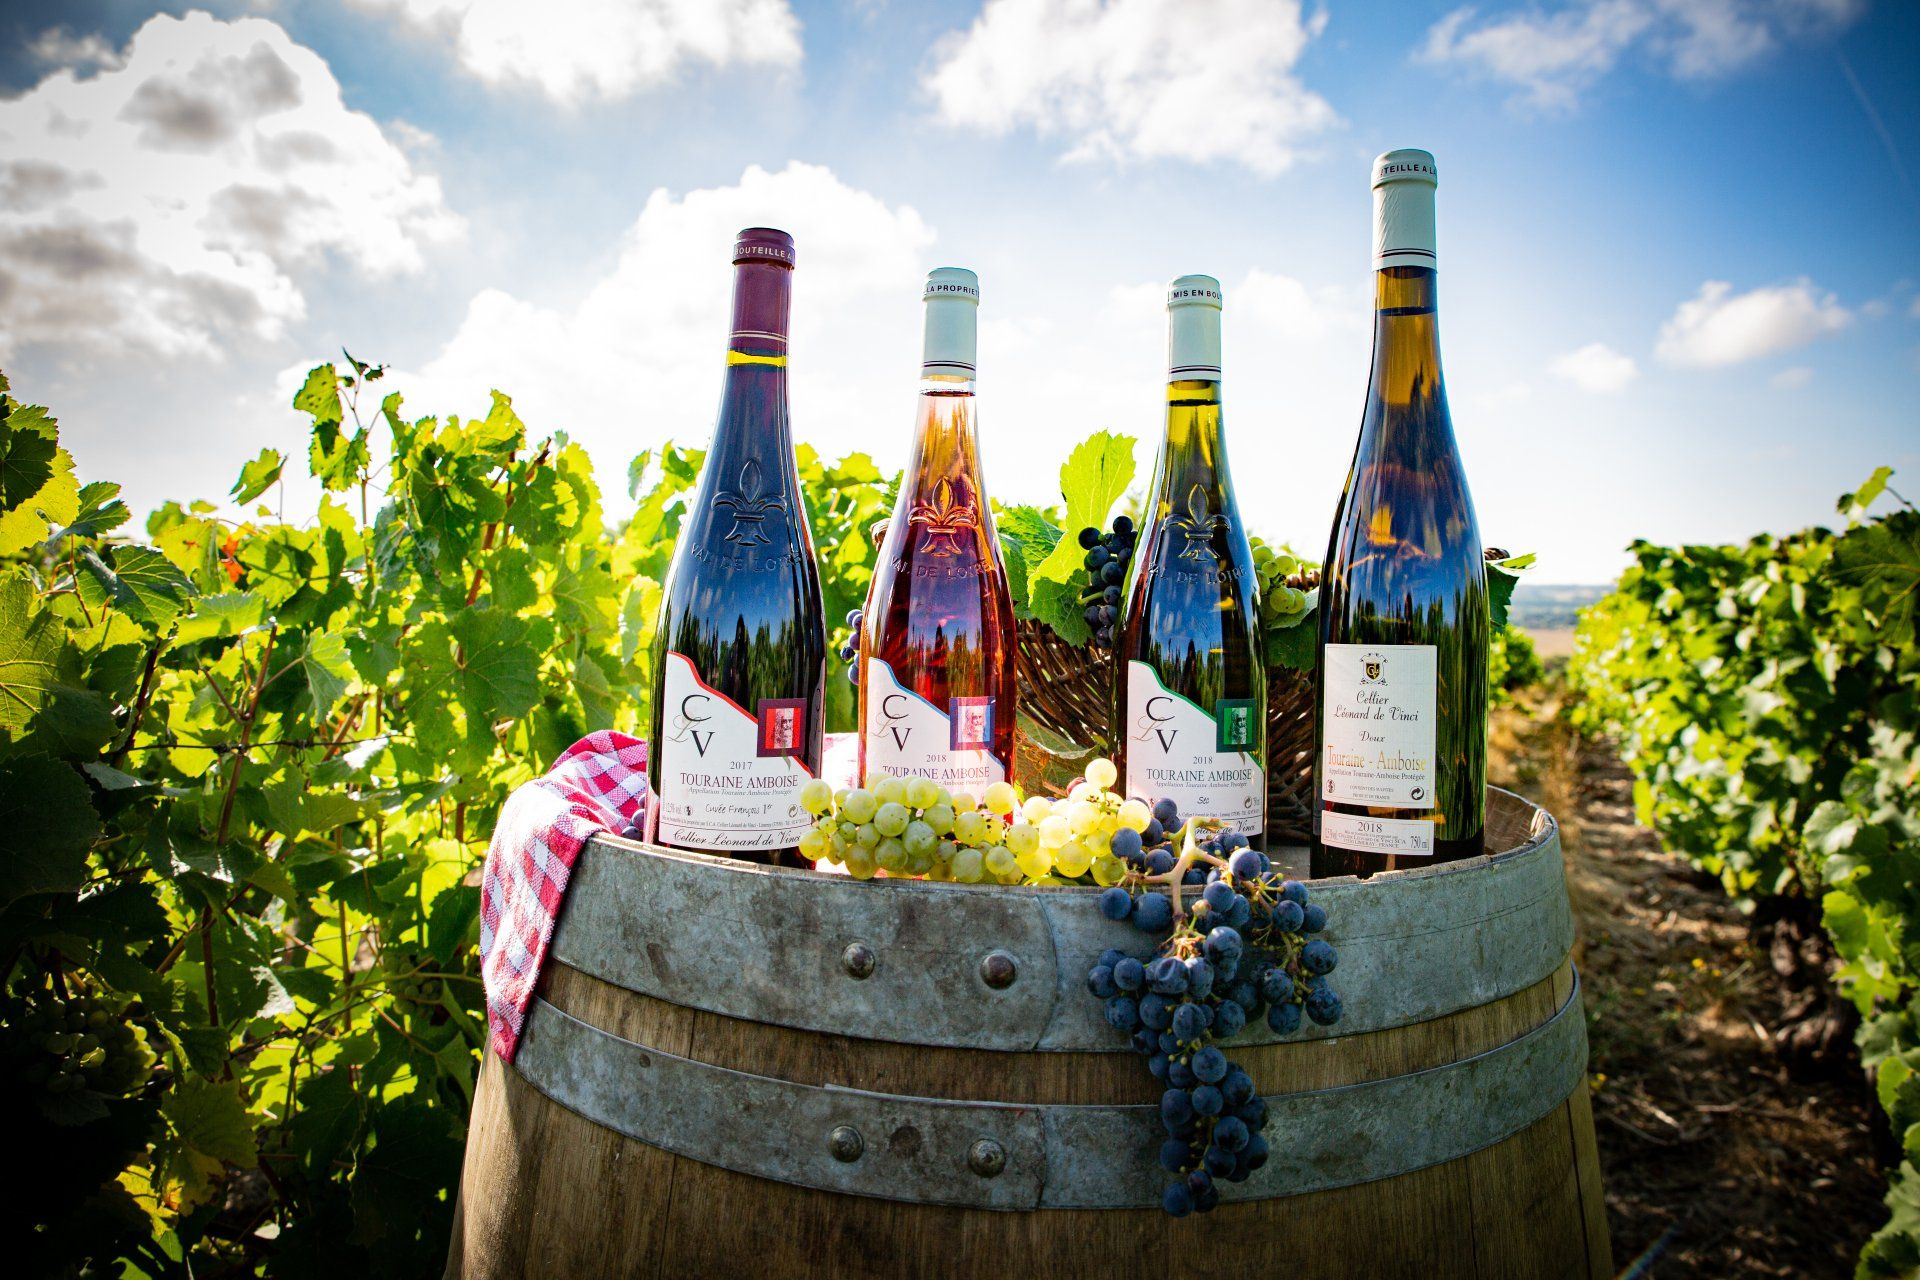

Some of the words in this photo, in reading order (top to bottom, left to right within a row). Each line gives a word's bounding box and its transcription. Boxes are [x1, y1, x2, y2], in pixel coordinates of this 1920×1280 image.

[1173, 290, 1189, 298] MIS
[916, 565, 938, 578] DE
[1355, 690, 1390, 706] Cellier
[681, 694, 712, 722] C
[882, 694, 909, 720] C
[1145, 696, 1175, 722] C
[1333, 704, 1370, 720] Léonard
[1373, 708, 1385, 720] de
[1389, 706, 1419, 722] Vinci
[690, 730, 716, 758] V
[890, 727, 913, 752] V
[1154, 729, 1178, 755] V
[1358, 730, 1386, 743] Doux
[729, 761, 753, 770] 2017
[925, 754, 947, 763] 2018
[1192, 756, 1213, 764] 2018
[1327, 745, 1365, 769] Touraine
[1376, 749, 1427, 771] Amboise
[680, 772, 747, 788] TOURAINE
[747, 774, 798, 788] AMBOISE
[941, 766, 990, 780] AMBOISE
[1146, 768, 1205, 782] TOURAINE
[1207, 768, 1252, 782] AMBOISE
[705, 803, 726, 814] Cuvée
[729, 804, 760, 817] François
[1236, 819, 1256, 832] Vinci
[1357, 821, 1383, 833] 2018
[673, 829, 707, 844] Cellier
[708, 832, 762, 847] Léonard
[762, 834, 773, 845] de
